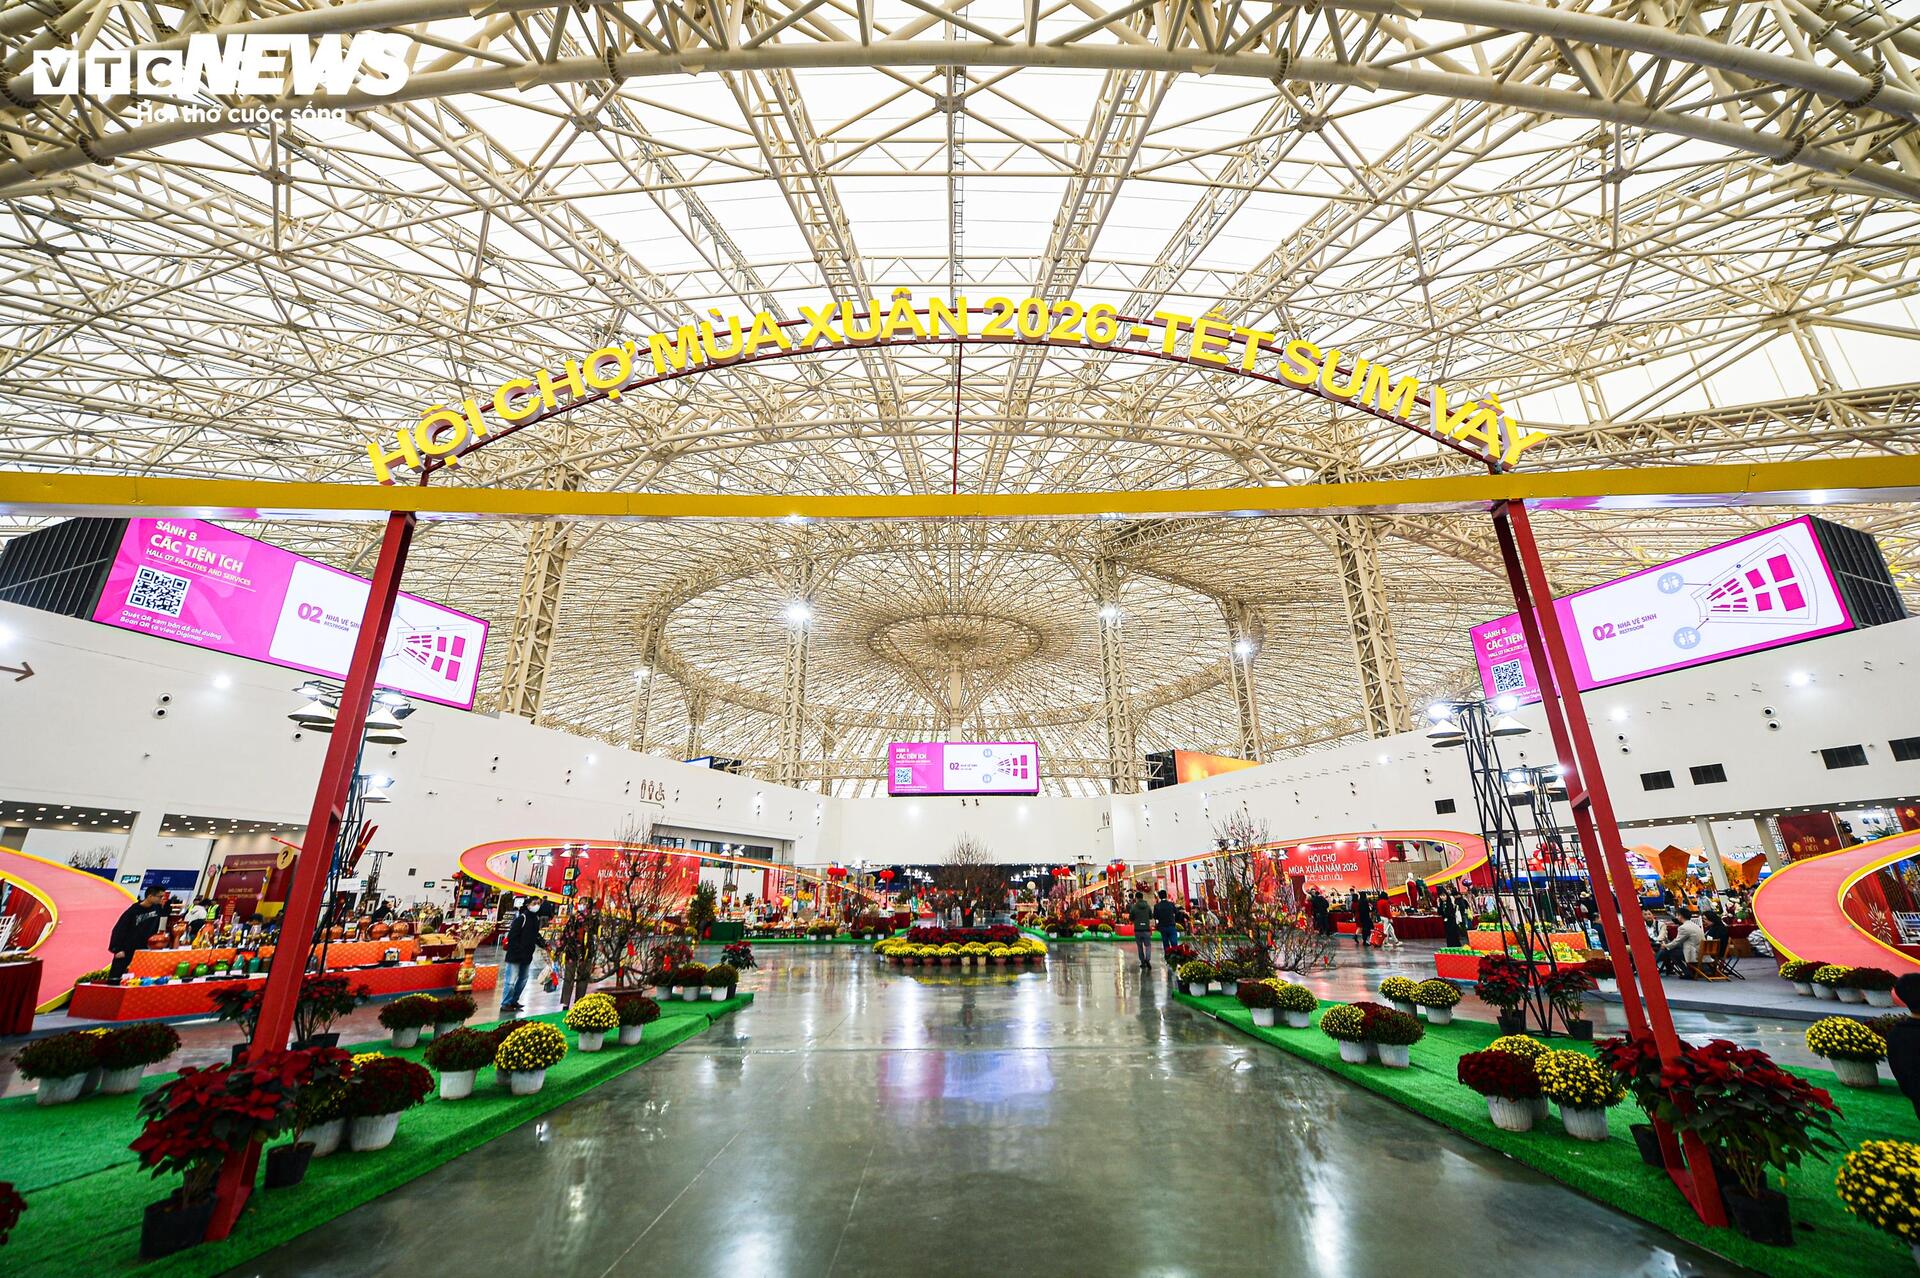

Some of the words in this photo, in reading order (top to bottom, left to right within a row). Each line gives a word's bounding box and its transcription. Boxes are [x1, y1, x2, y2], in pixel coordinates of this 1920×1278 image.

[367, 400, 491, 484] HỘI
[494, 340, 638, 426] CHỢ
[648, 307, 793, 378] MÙA
[798, 287, 969, 350] XUÂN
[981, 297, 1118, 349] 2026
[1154, 306, 1275, 375] TẾT
[1276, 339, 1419, 424] SUM
[1430, 384, 1549, 468] VẦY
[188, 532, 198, 541] 8
[145, 548, 164, 559] HALL
[207, 567, 222, 577] AND
[298, 602, 323, 624] 02
[1592, 622, 1617, 641] 02
[949, 762, 960, 770] 02
[1304, 863, 1325, 874] XUÂN
[1342, 862, 1358, 872] 2026
